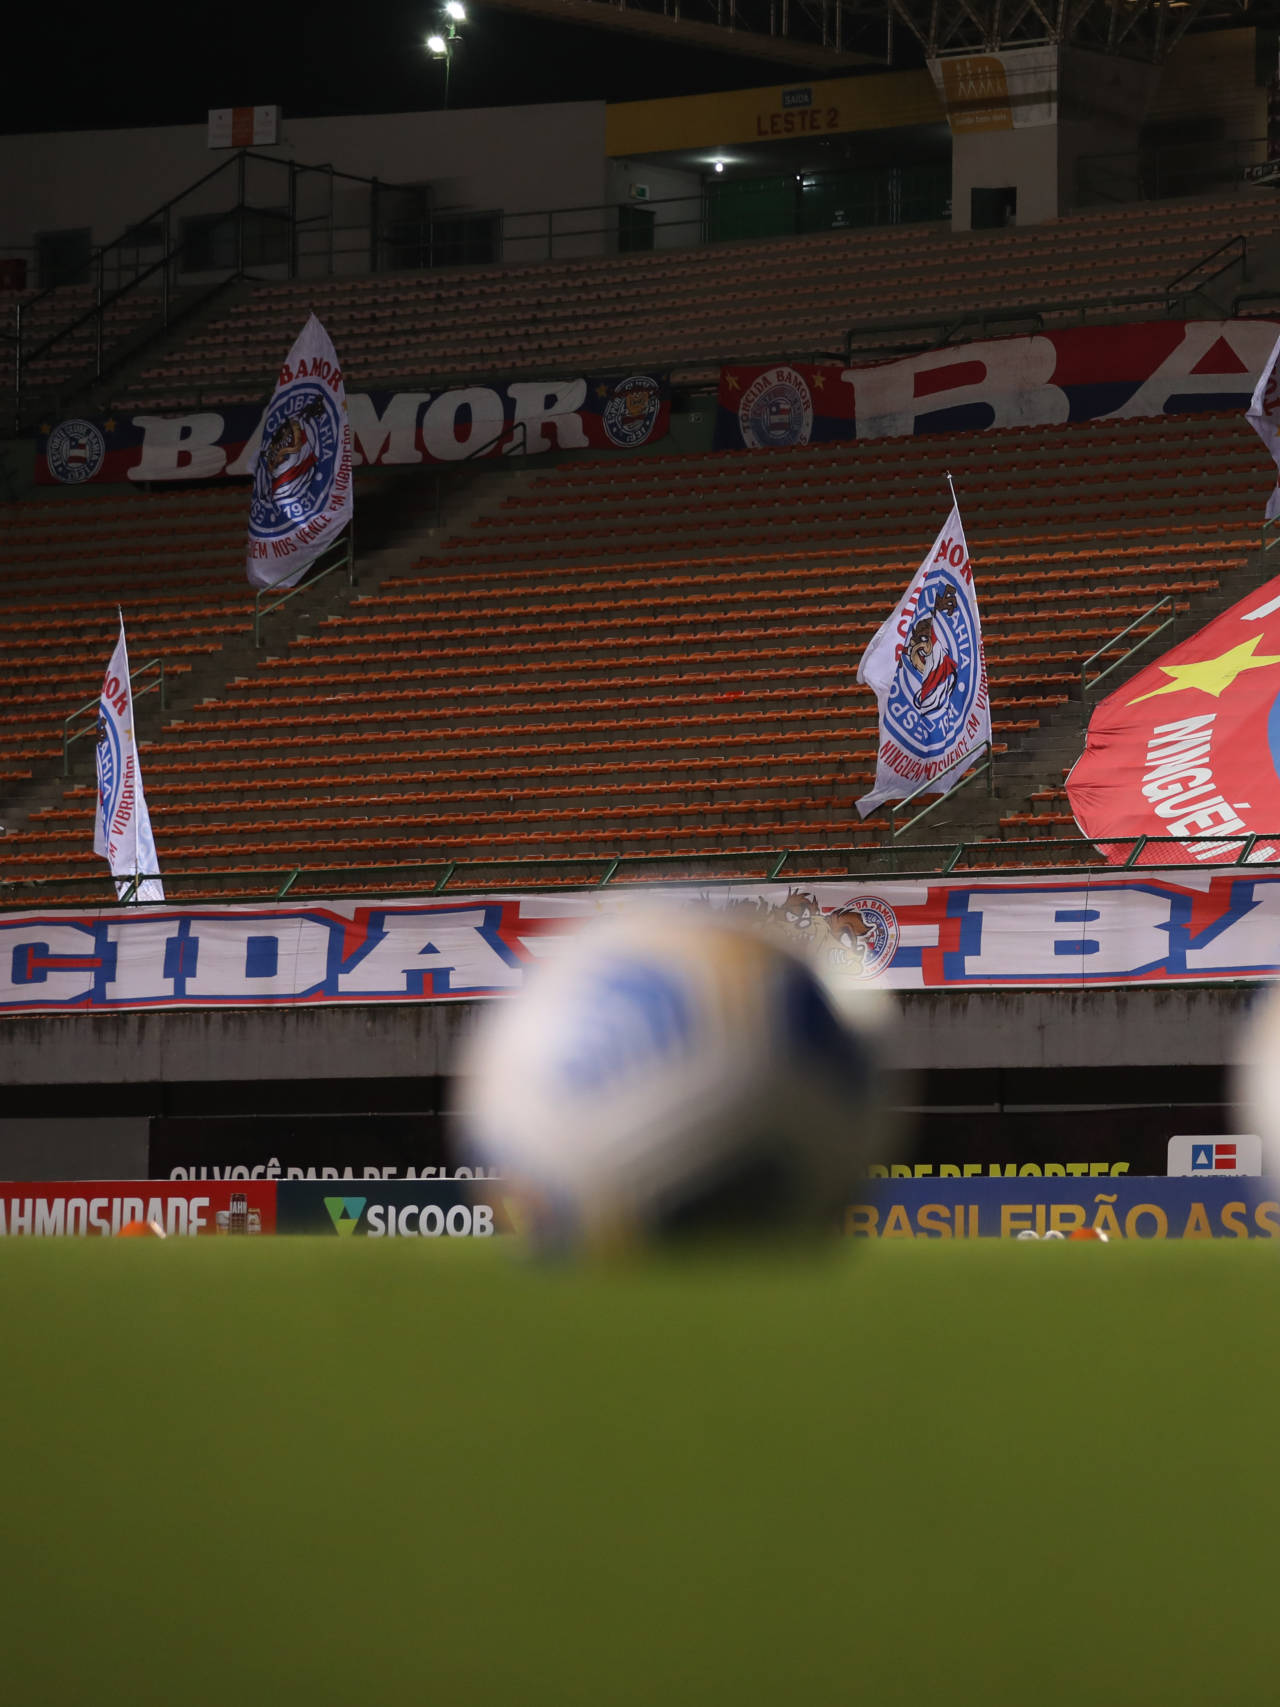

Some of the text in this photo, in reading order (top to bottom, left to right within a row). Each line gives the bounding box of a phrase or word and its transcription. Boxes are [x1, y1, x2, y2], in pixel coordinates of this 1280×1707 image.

[757, 107, 839, 136] LESTE 2
[279, 357, 344, 392] BAMOR
[776, 370, 810, 412] BAMOR
[318, 411, 334, 462] AHIA
[283, 490, 316, 519] 1931
[272, 537, 298, 558] NOS
[295, 513, 332, 545] VENCE
[329, 494, 347, 512] EM
[951, 610, 971, 669] AHIA
[965, 713, 981, 739] EM
[1141, 713, 1257, 861] NINGUÉM
[870, 900, 895, 930] BAMOR
[0, 907, 524, 1001] CIDA
[366, 1204, 495, 1238] SICOOB
